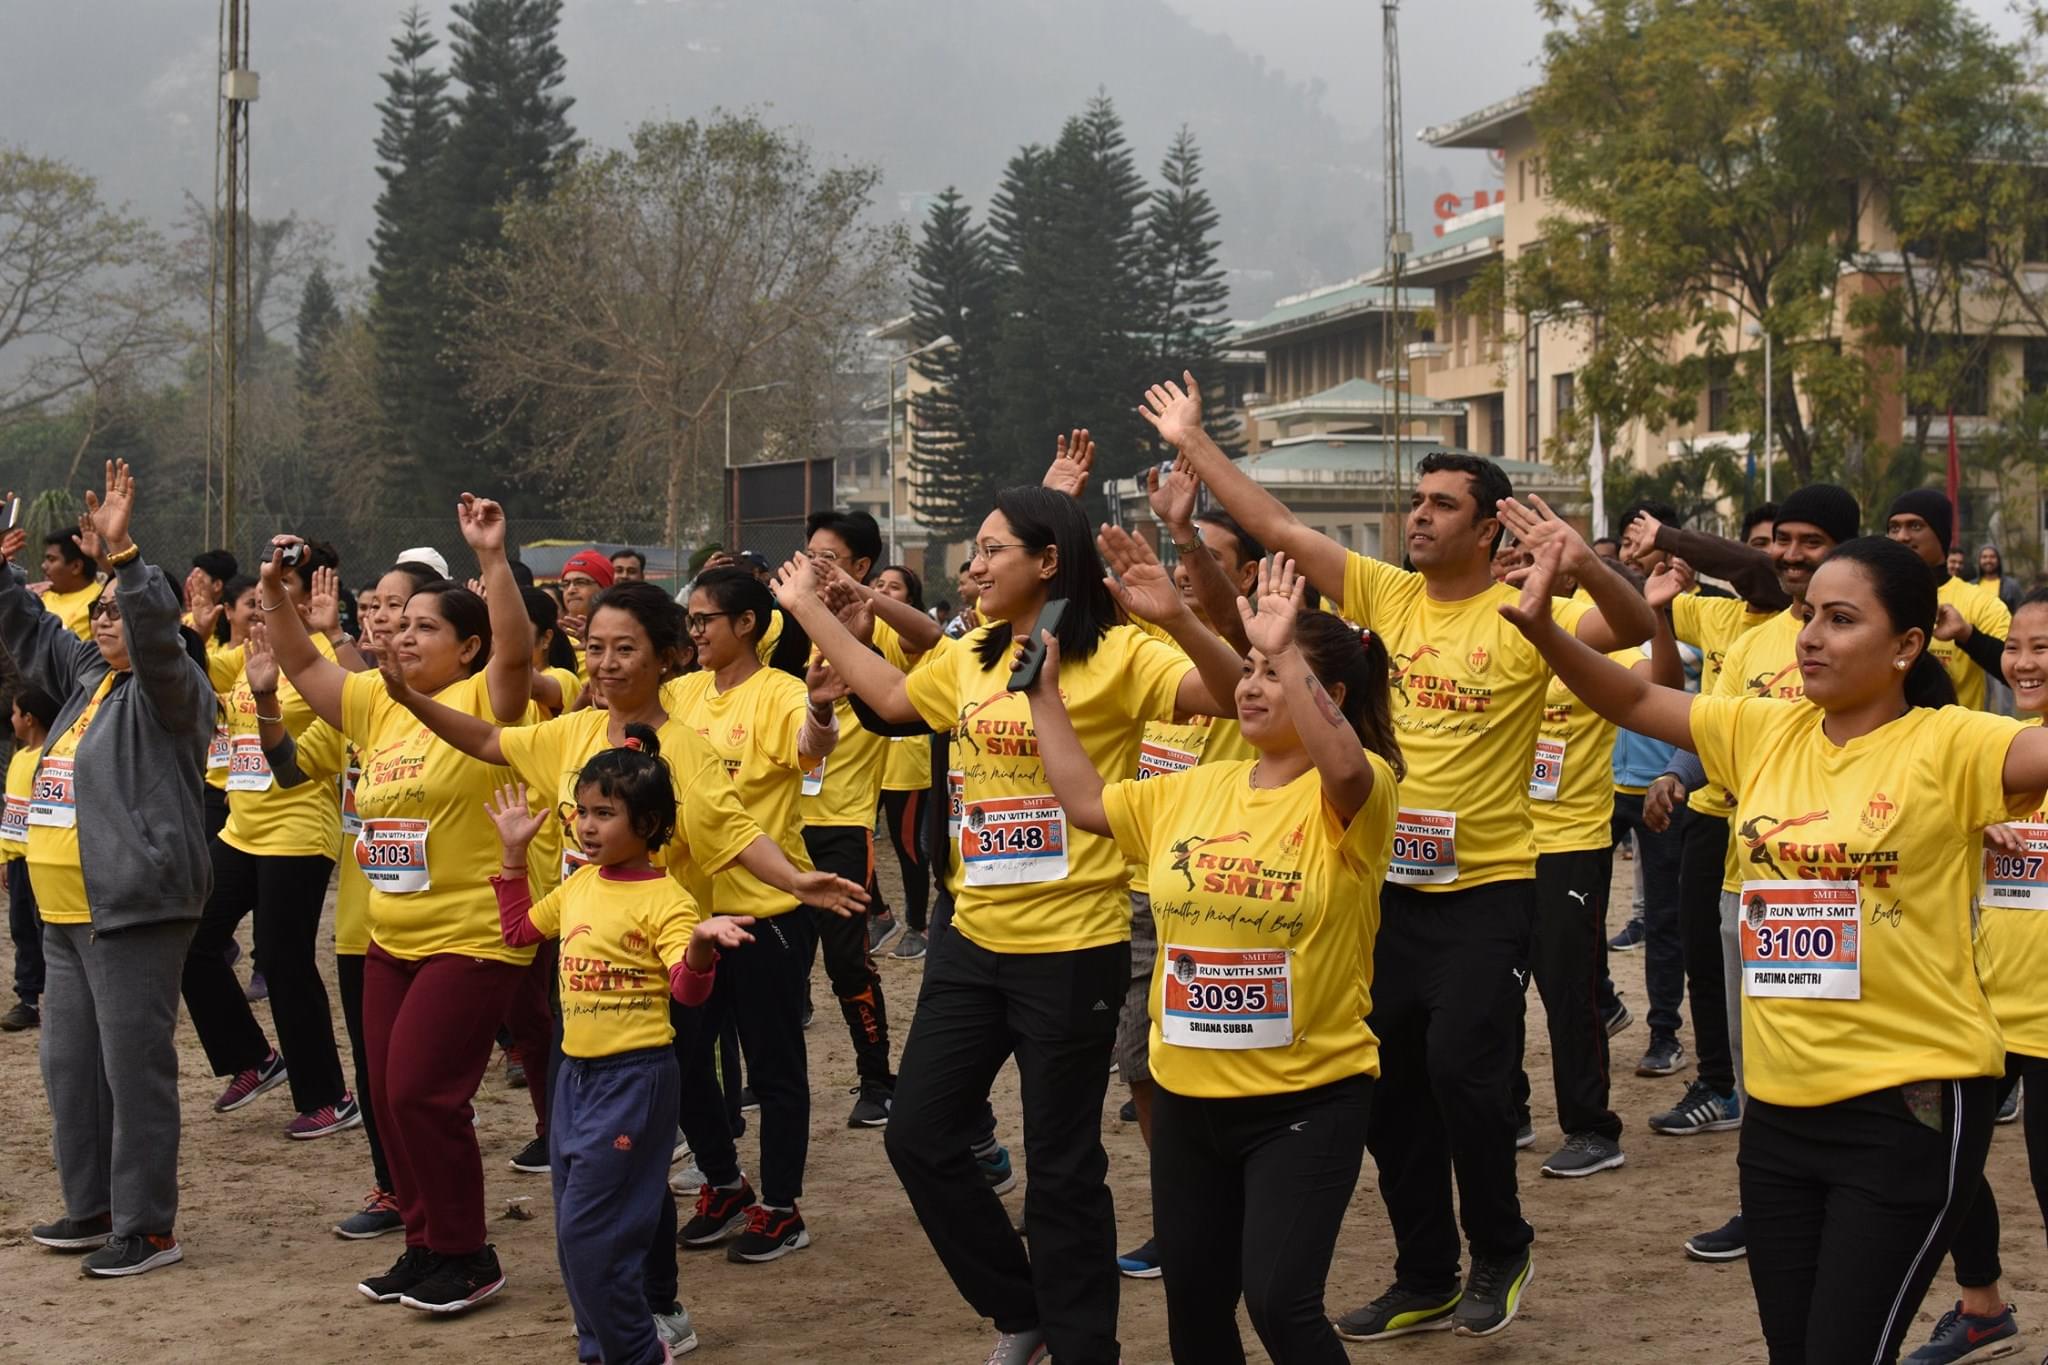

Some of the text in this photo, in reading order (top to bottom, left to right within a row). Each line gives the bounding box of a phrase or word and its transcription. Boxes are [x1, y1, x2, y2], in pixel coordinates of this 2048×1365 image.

[1408, 675, 1491, 696] RUN WITH
[1416, 692, 1491, 712] SMIT
[975, 719, 1027, 737] RUN
[1153, 758, 1173, 769] WITH
[373, 763, 424, 786] SMIT
[2, 811, 28, 826] 00
[987, 809, 1059, 823] RUN WITH SMIT
[978, 827, 1044, 853] 3148
[1407, 826, 1429, 835] WITH
[1430, 827, 1451, 837] SMIT
[368, 845, 411, 864] 3103
[1778, 841, 1898, 864] RUN WITH
[1195, 853, 1302, 881] RUN WITH
[1994, 856, 2043, 879] 3097
[1203, 872, 1302, 902] SMIT
[1813, 890, 1839, 899] SMIT
[1162, 901, 1201, 926] Healthy
[1204, 905, 1242, 931] Mind
[1238, 910, 1269, 934] and
[1267, 912, 1304, 938] Body
[1769, 906, 1856, 917] RUN WITH SMIT
[1870, 900, 1903, 928] Body
[1757, 927, 1835, 957] 3100
[563, 955, 612, 974] RUN
[1242, 952, 1267, 961] SMIT
[1199, 966, 1285, 977] RUN WITH SMIT
[1754, 972, 1822, 985] PRATIMA CHETTRI
[569, 972, 649, 992] SMIT
[1188, 984, 1266, 1011] 3095
[1190, 1021, 1254, 1034] SRIJANA SUBBA
